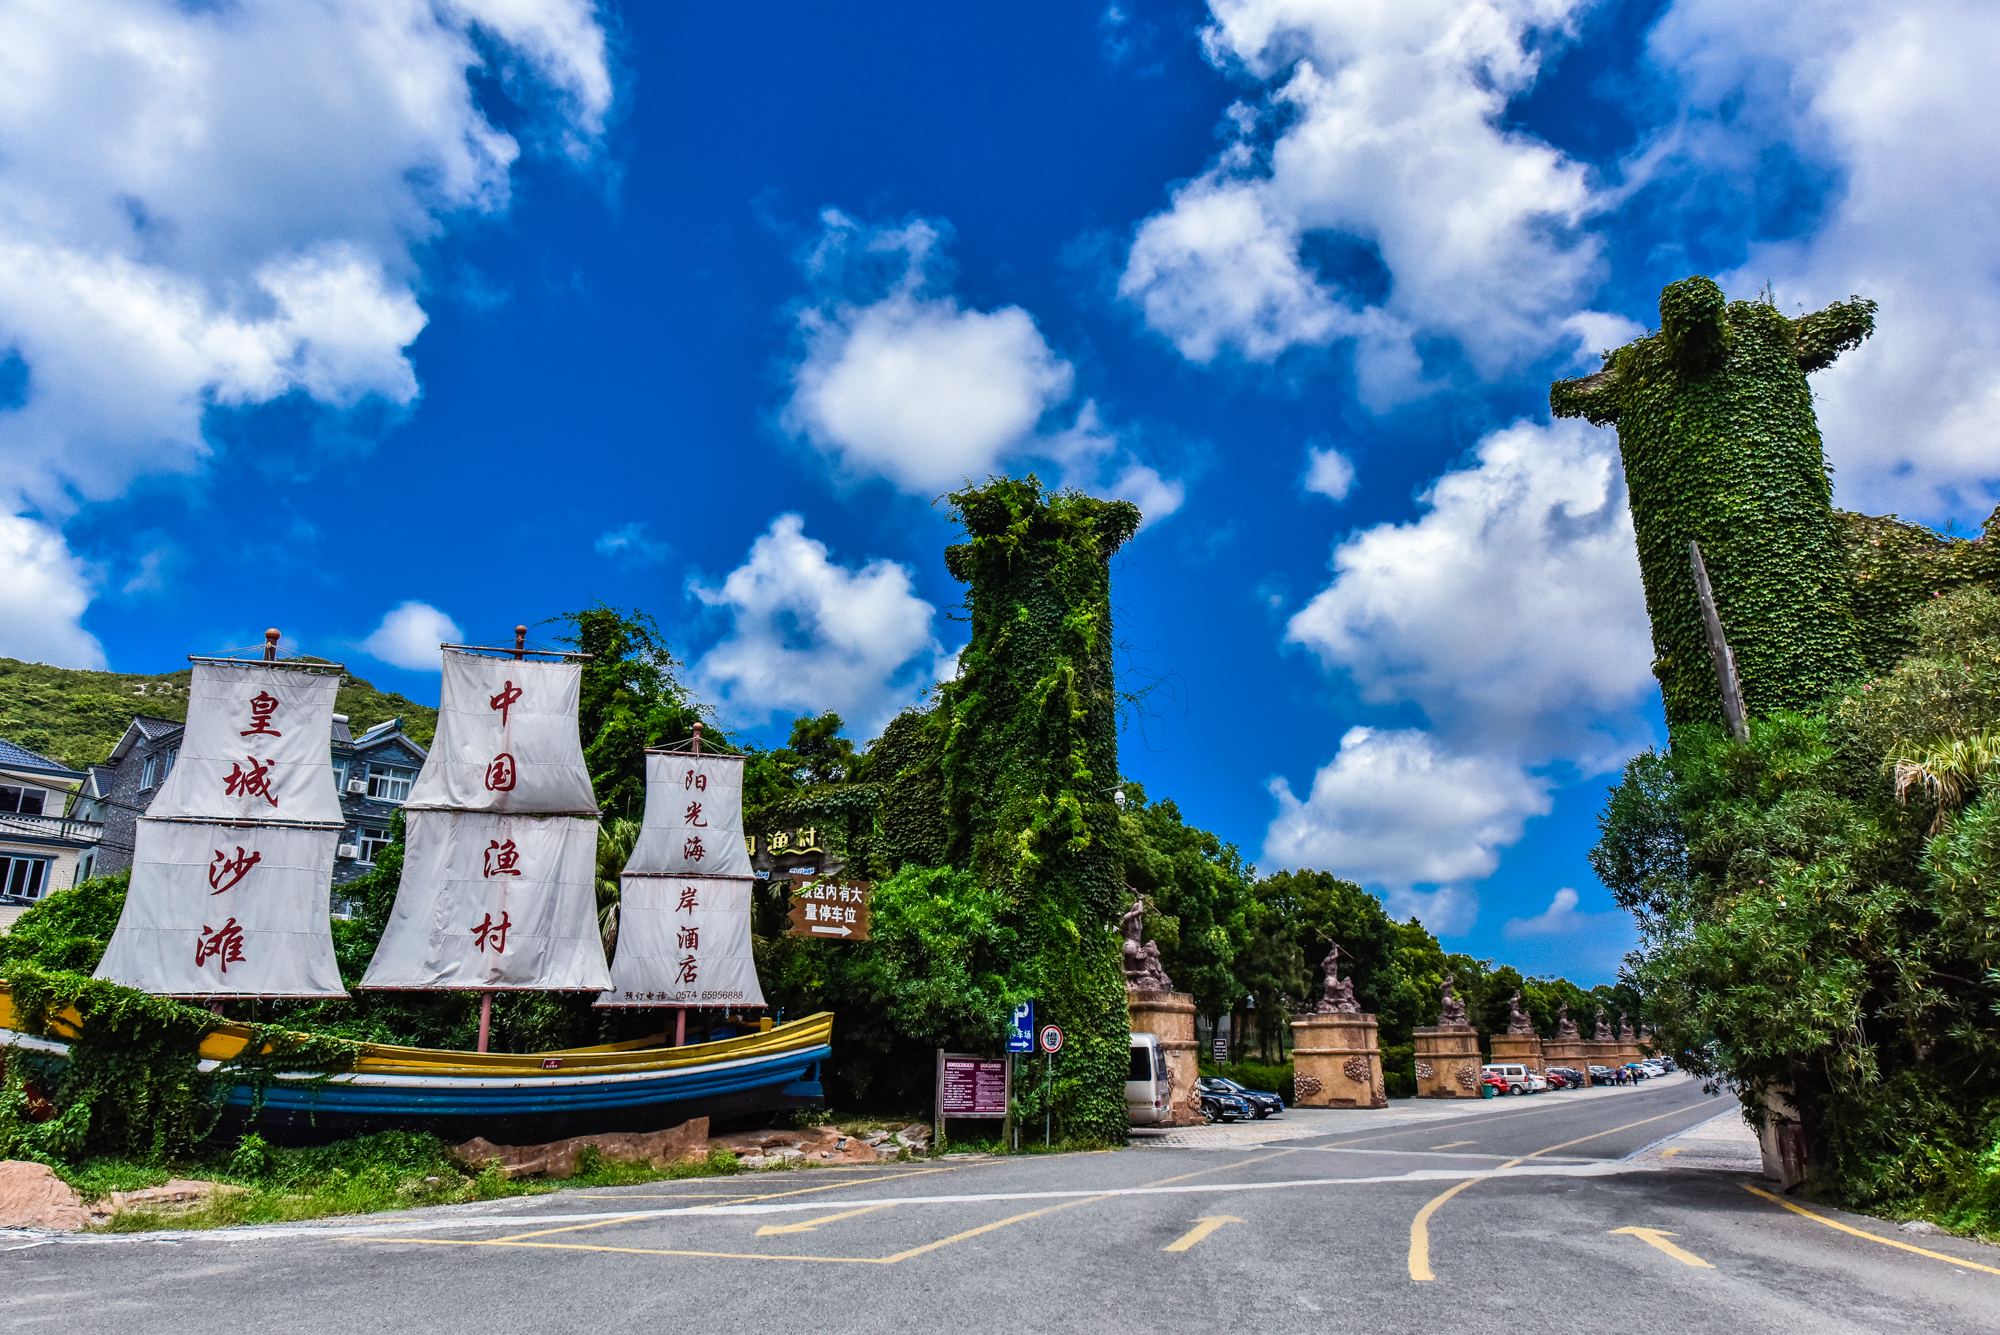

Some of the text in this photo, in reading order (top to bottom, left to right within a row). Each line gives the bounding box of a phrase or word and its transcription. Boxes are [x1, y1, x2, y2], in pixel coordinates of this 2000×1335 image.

[195, 690, 282, 974] 皇城沙滩
[470, 680, 523, 955] 中国渔村
[674, 768, 708, 985] 阳光海岸酒店
[801, 881, 863, 903] 景区内有大
[804, 903, 857, 923] 量停车位
[624, 991, 744, 1000] 预订电话 0574 65956888
